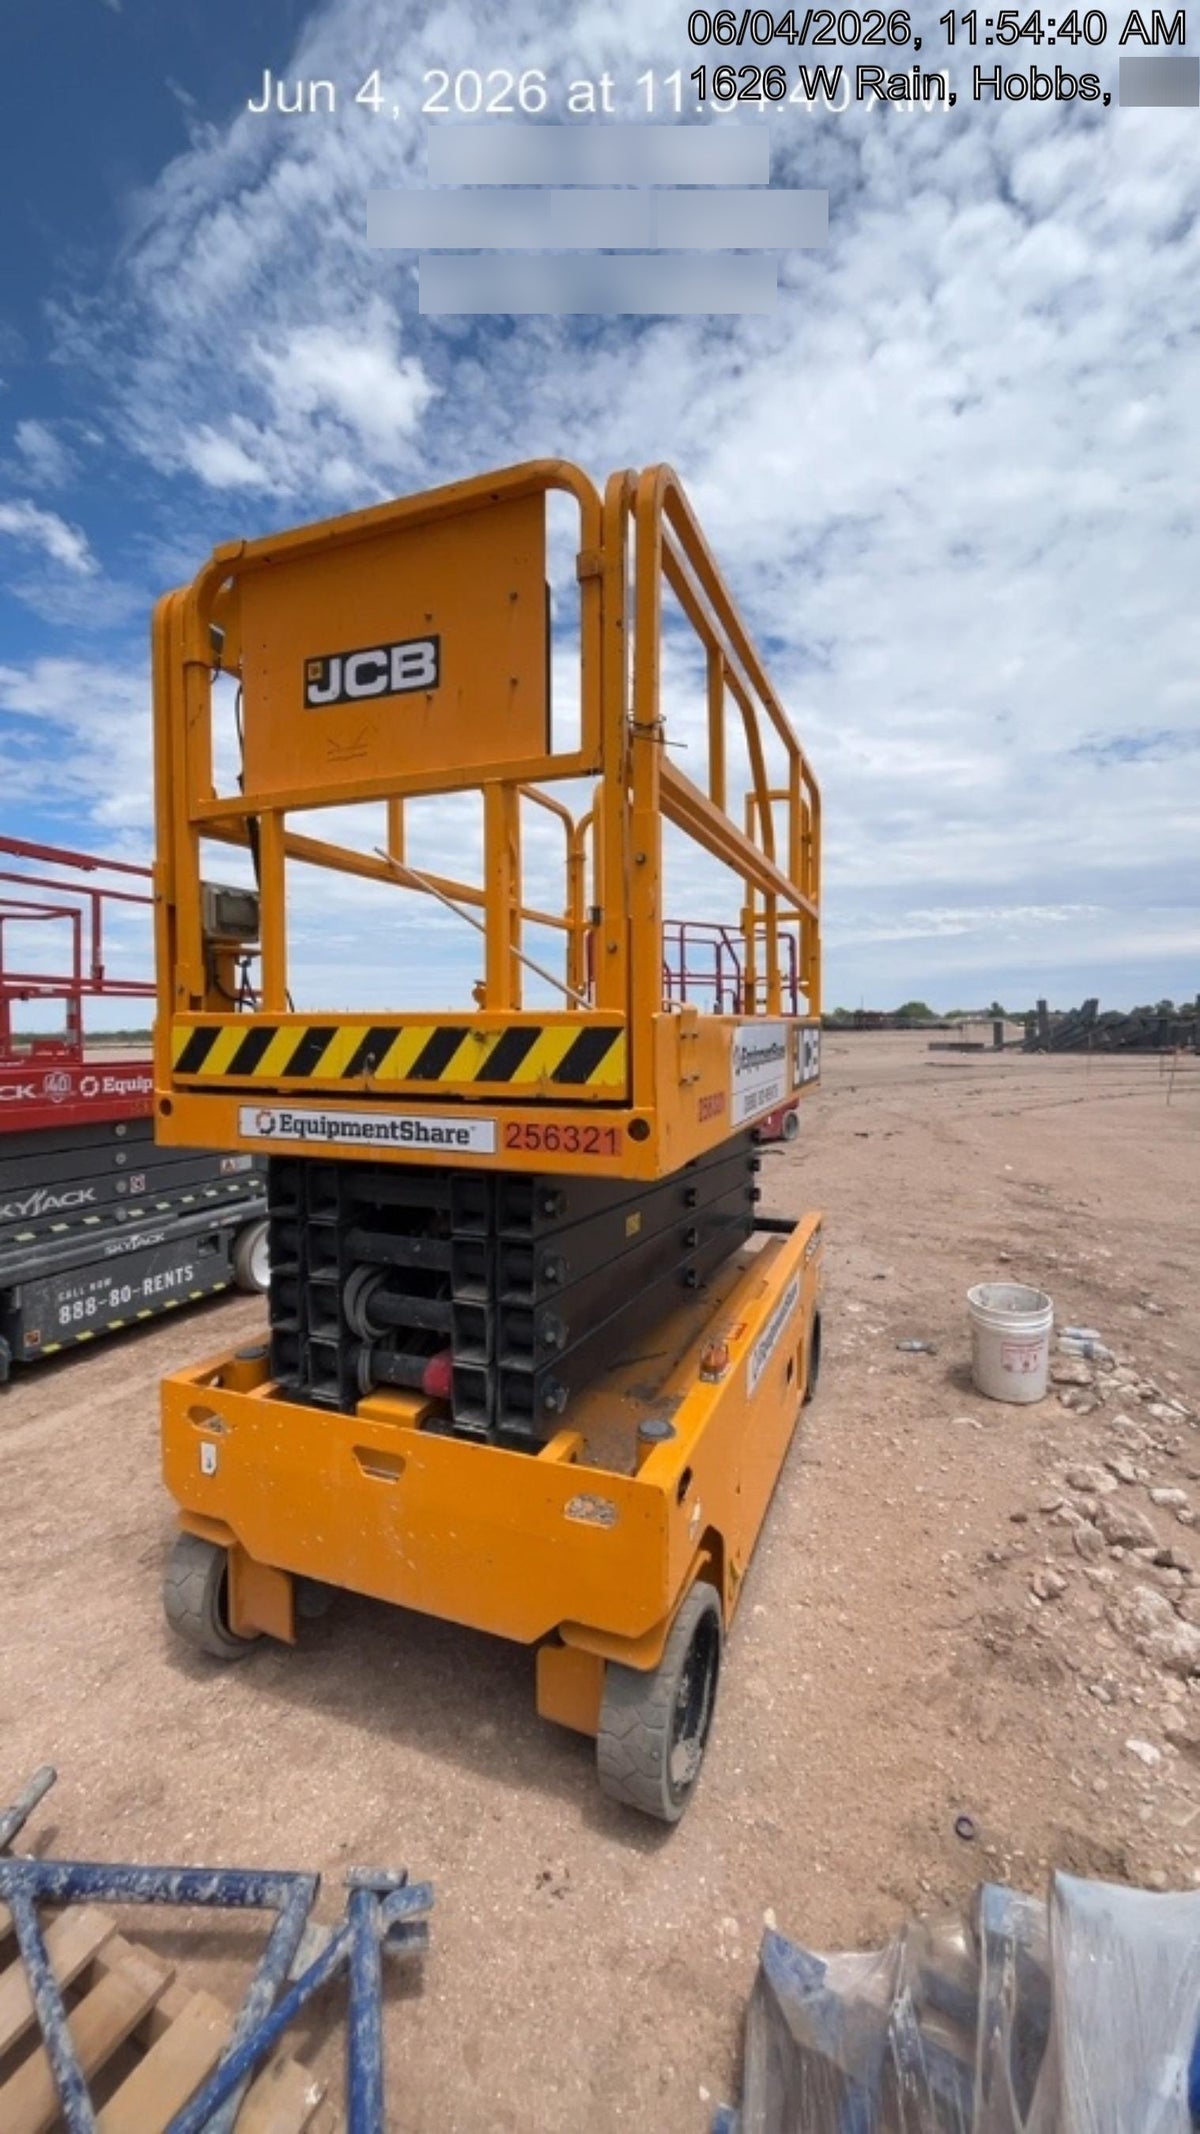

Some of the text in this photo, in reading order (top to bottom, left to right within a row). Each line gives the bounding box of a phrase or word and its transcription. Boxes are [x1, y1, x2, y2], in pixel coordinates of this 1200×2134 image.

[307, 641, 437, 704] JCB
[279, 1112, 470, 1145] EquipmentShare
[505, 1121, 616, 1155] 256321
[59, 1265, 193, 1324] 888-80-RENTS
